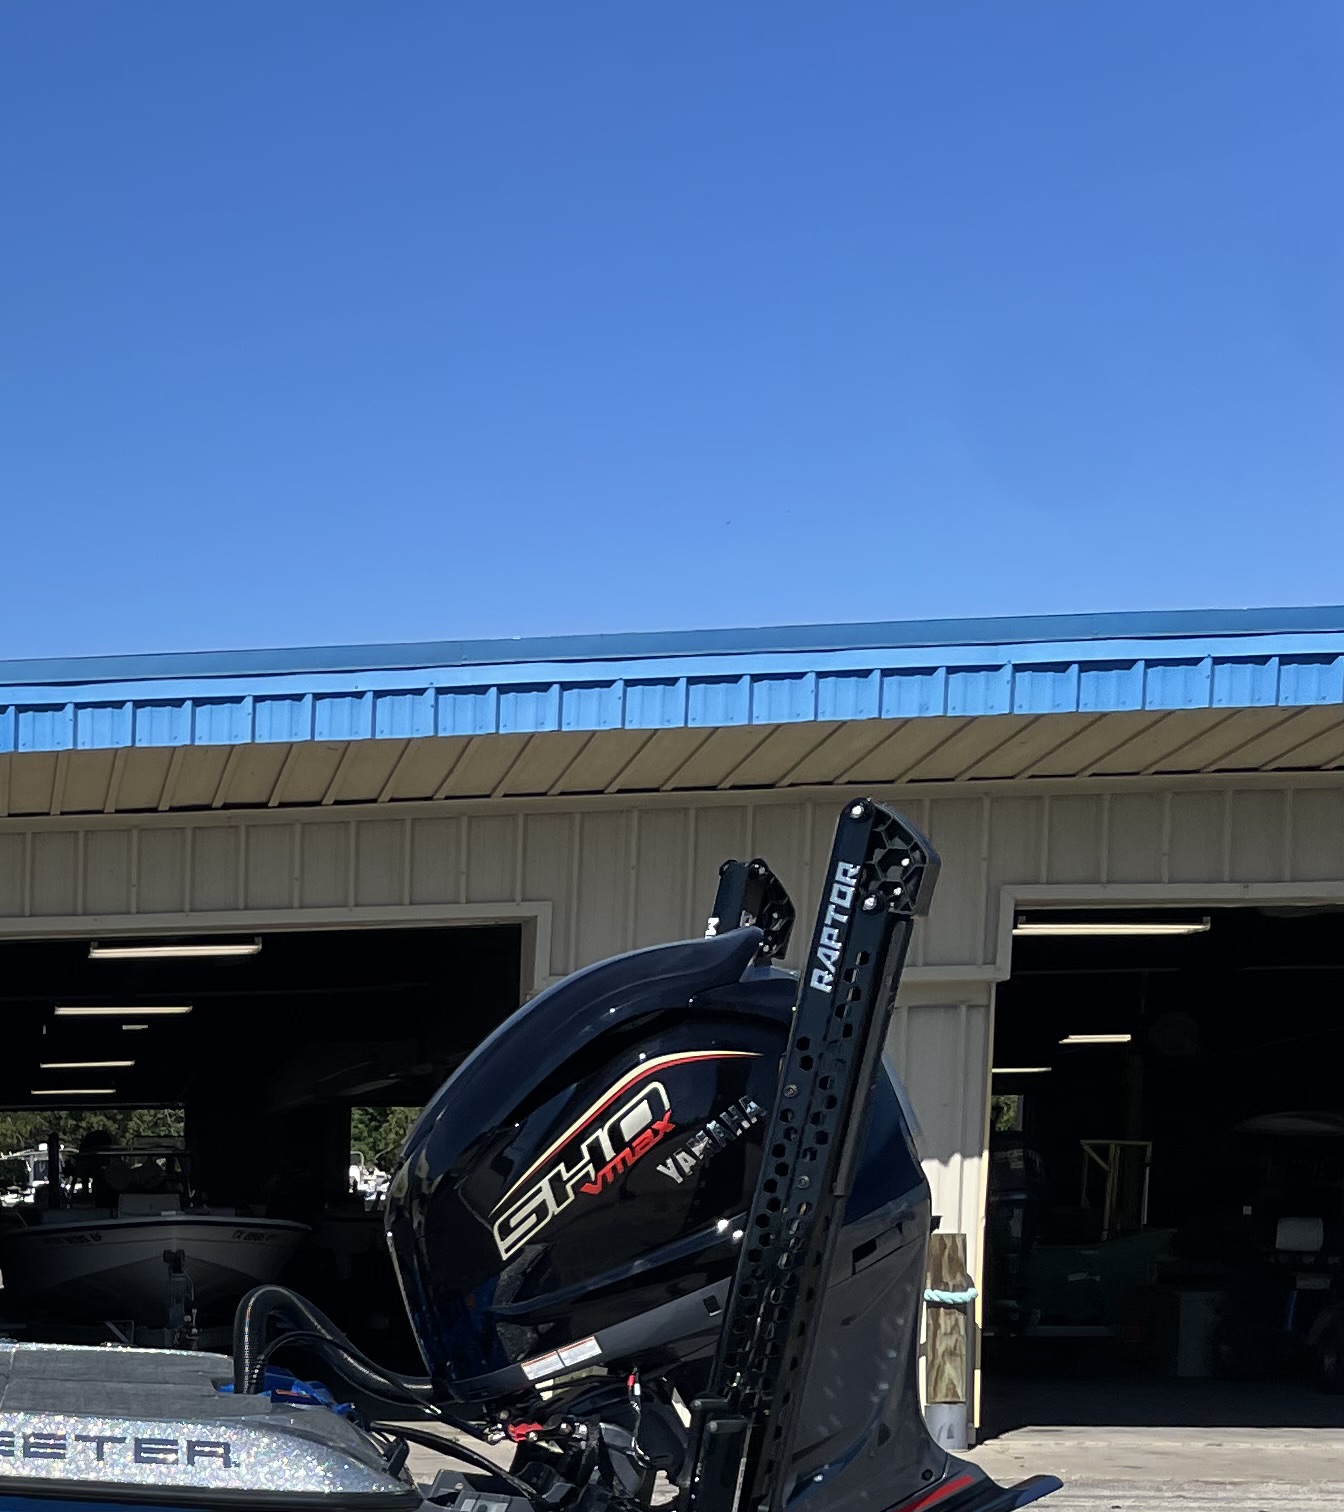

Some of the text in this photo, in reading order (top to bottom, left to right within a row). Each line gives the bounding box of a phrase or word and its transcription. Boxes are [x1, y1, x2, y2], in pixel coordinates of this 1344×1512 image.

[810, 860, 861, 993] RAPTOR
[493, 1081, 672, 1261] SHO
[656, 1095, 766, 1185] YAMAHA
